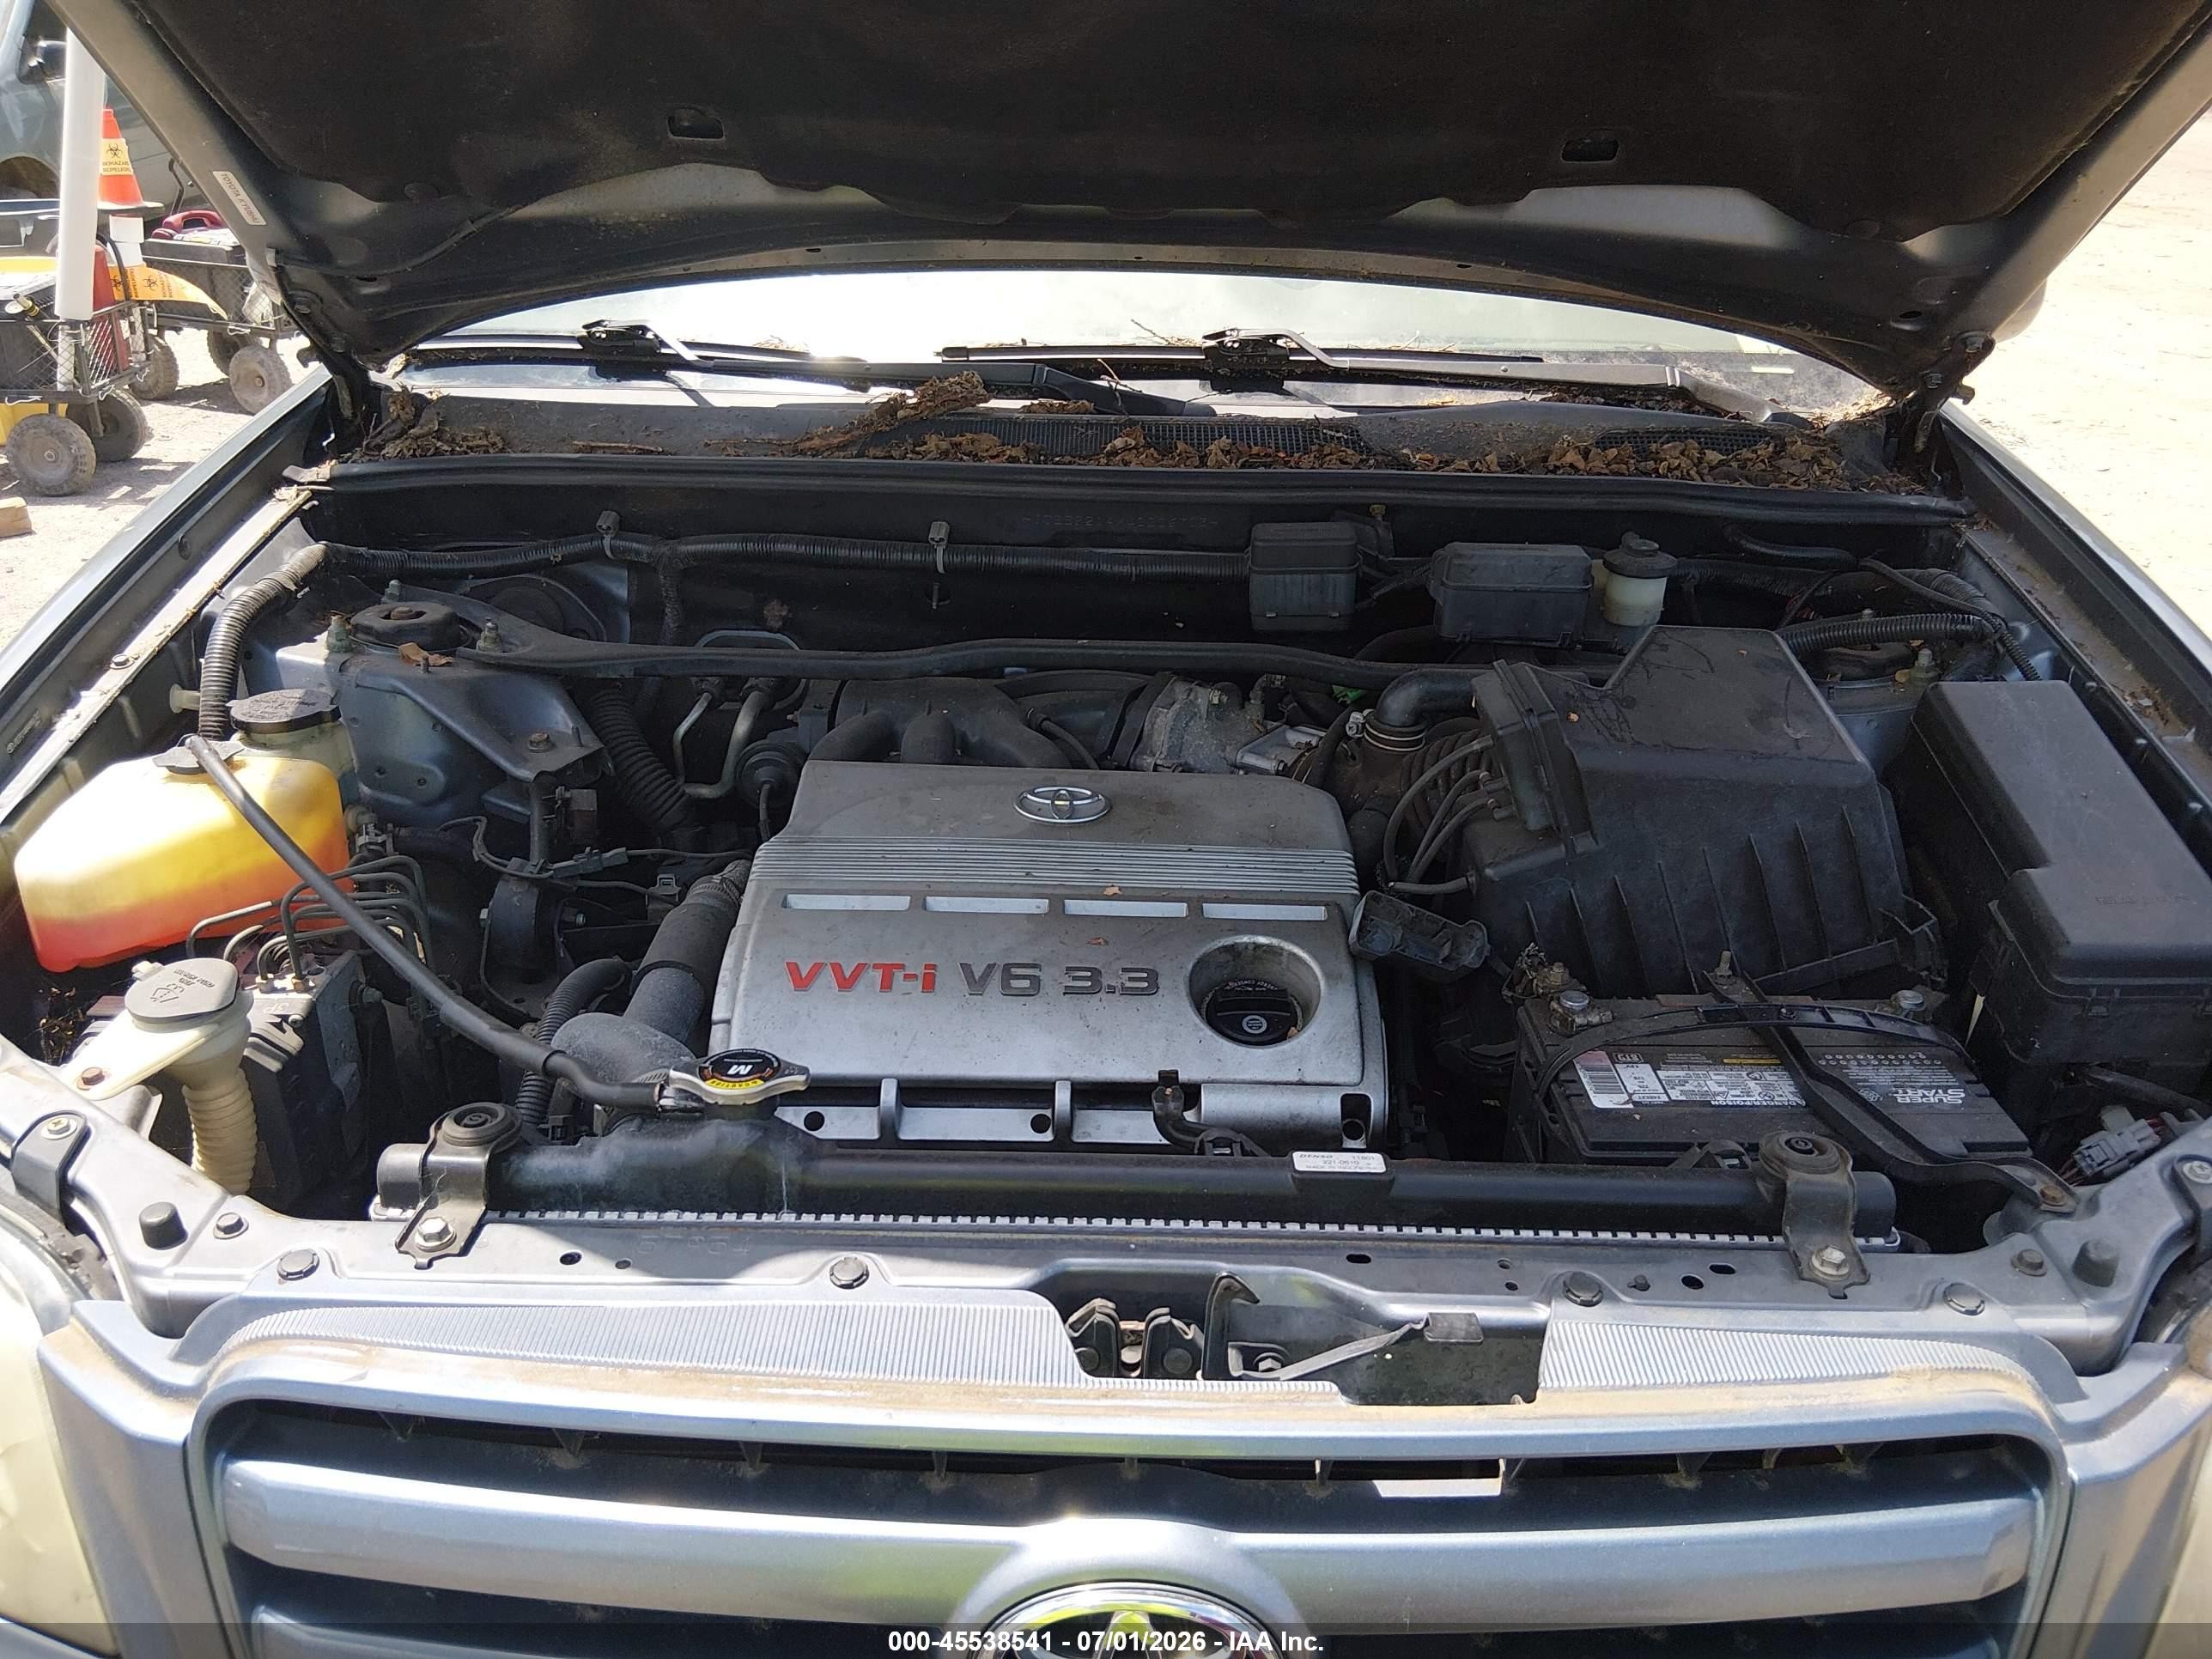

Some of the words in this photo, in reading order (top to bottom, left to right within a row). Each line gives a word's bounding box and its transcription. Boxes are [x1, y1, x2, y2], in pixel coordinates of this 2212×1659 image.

[221, 173, 240, 198] TOYOTA
[785, 961, 938, 993] VVT-i
[958, 962, 1042, 996] V6
[1062, 965, 1159, 996] 3.3
[1893, 1088, 1966, 1097] START
[1896, 1096, 1963, 1104] SUPER
